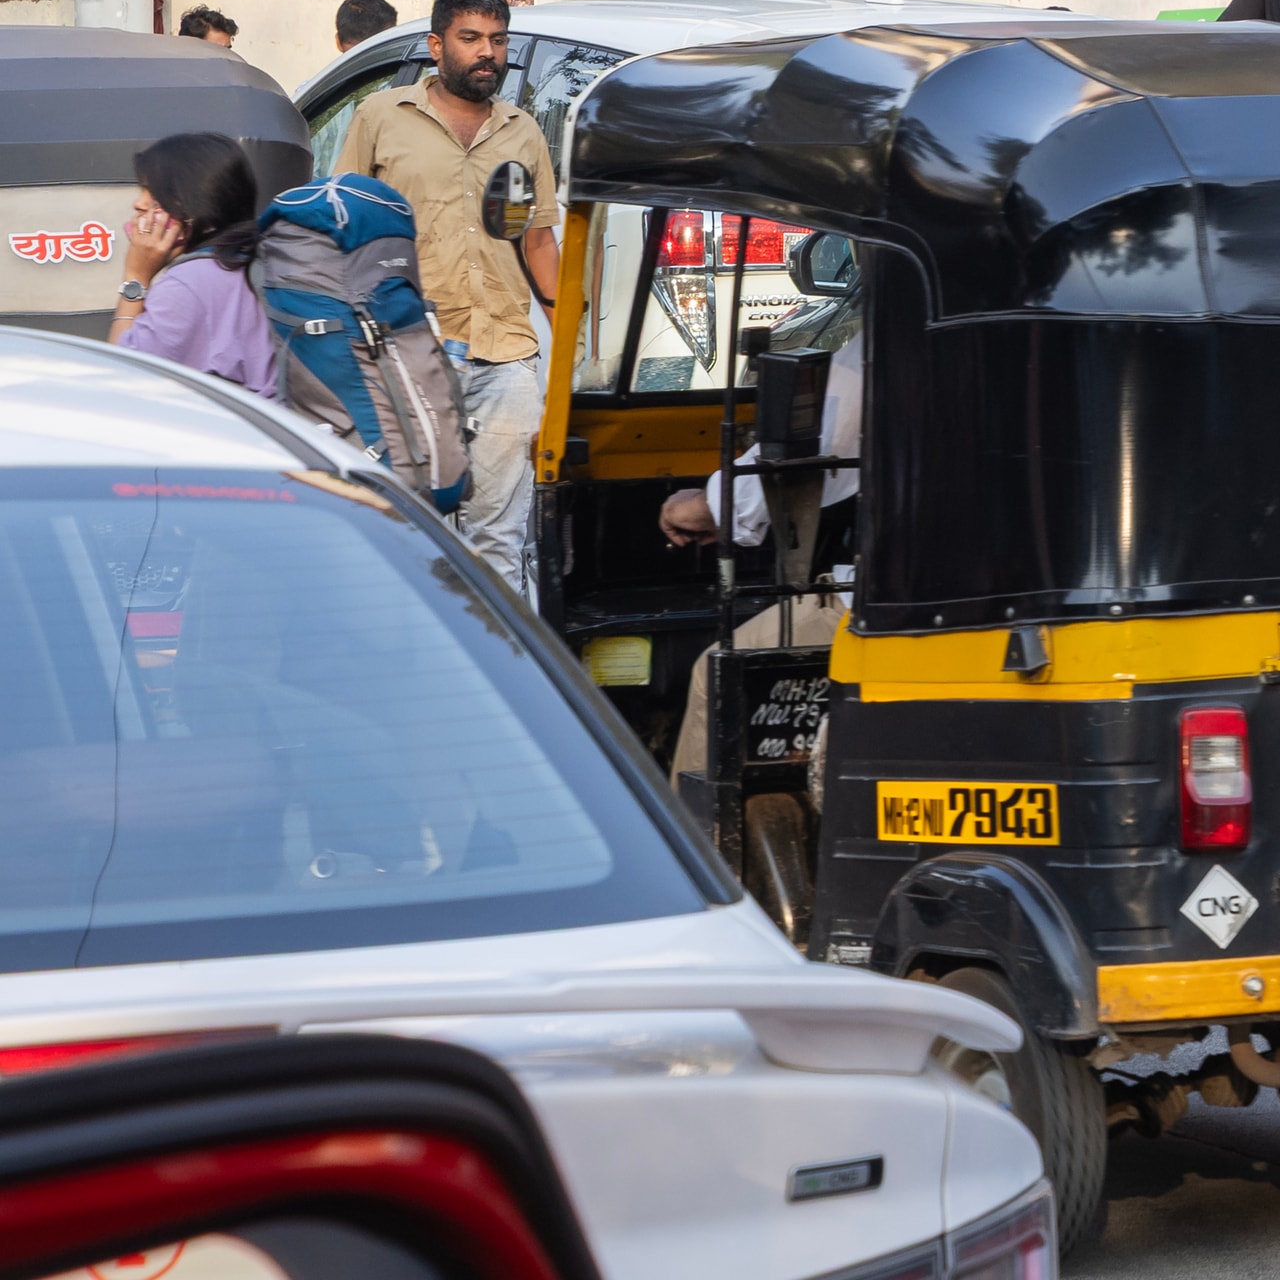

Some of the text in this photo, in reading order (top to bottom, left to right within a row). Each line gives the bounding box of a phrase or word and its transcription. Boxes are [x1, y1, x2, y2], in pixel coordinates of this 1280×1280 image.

[738, 293, 808, 308] NNOVA
[948, 788, 1053, 839] 7943
[1196, 895, 1241, 917] CNG
